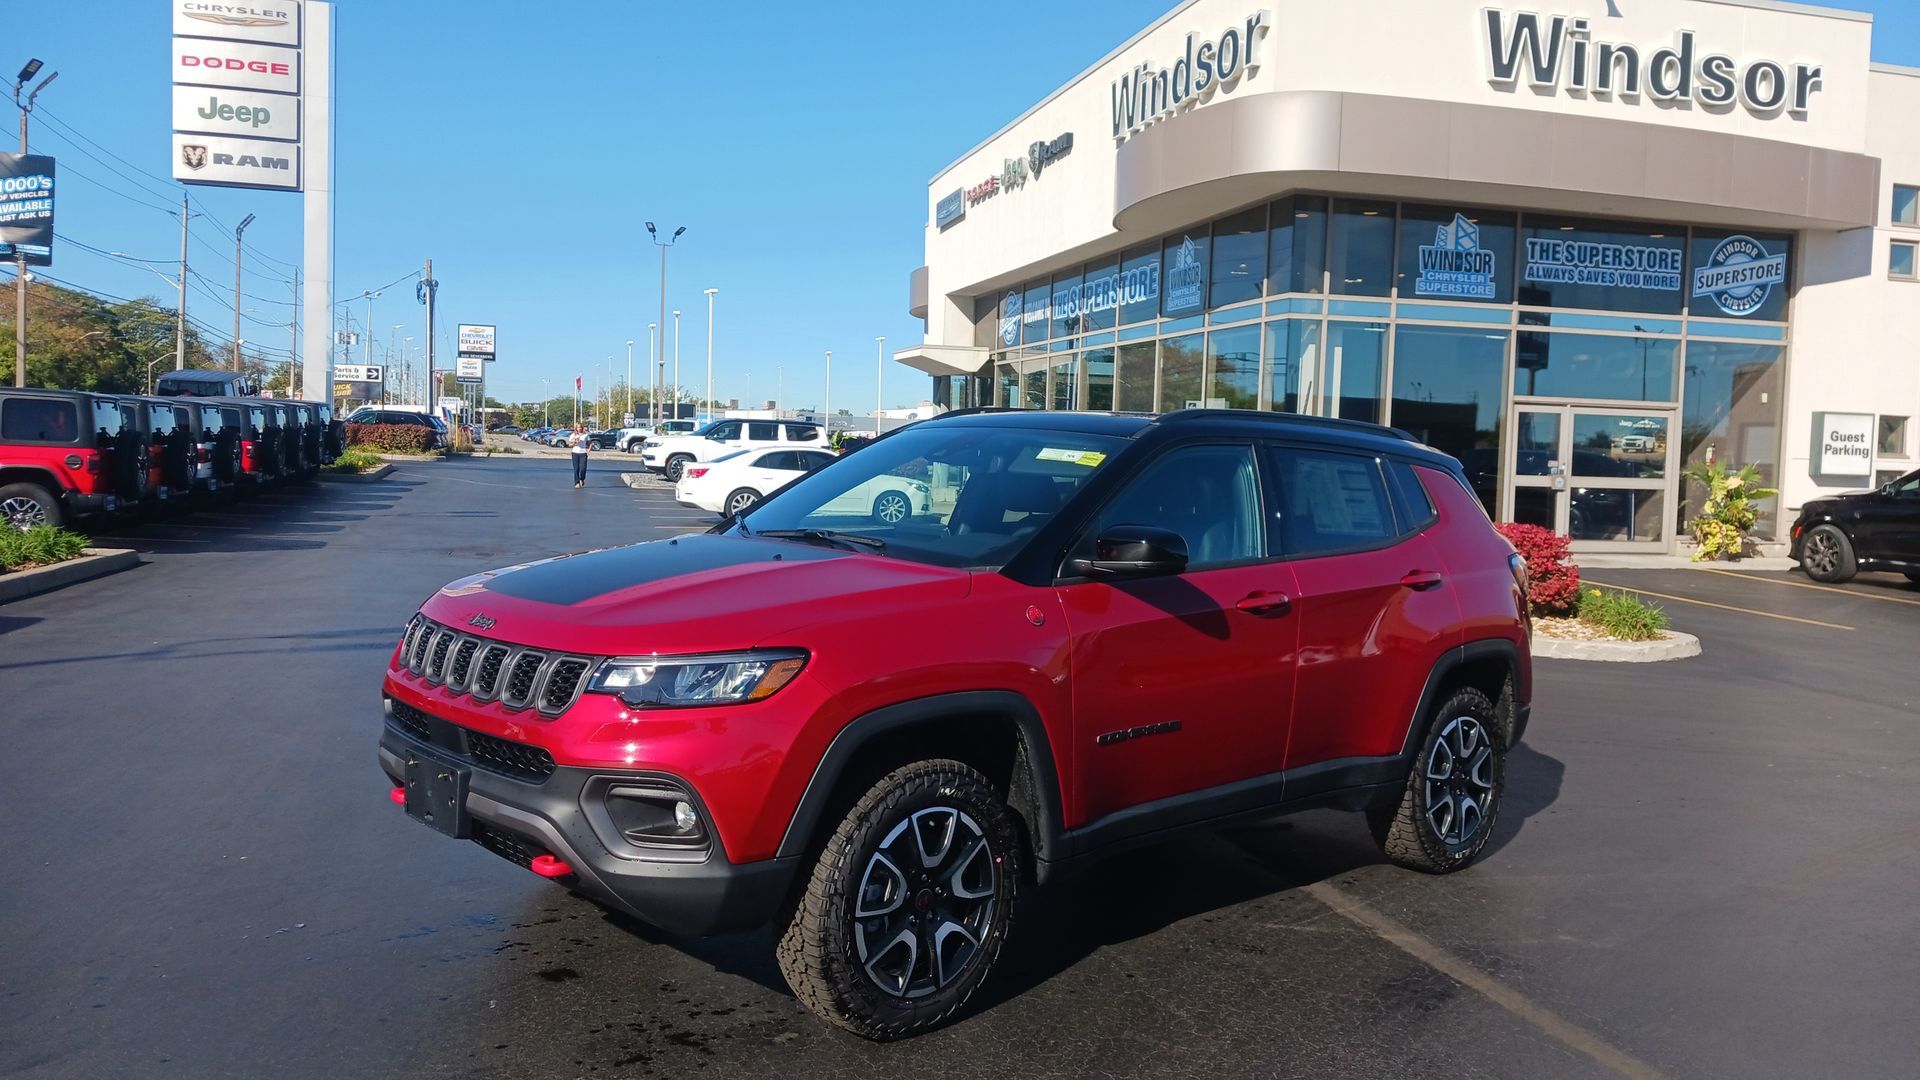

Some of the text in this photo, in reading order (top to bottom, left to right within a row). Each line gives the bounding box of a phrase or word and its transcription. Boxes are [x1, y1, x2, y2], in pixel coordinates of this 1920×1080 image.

[183, 2, 288, 19] CHRYSLER
[181, 54, 290, 76] DODGE
[1485, 8, 1822, 111] Windsor
[1111, 10, 1267, 139] Windsor
[197, 96, 271, 128] Jeep
[213, 152, 289, 170] RAM
[9, 190, 50, 199] VEHICLES
[0, 210, 51, 222] UST ASK US
[1421, 248, 1493, 274] WINDSOR
[1528, 240, 1681, 271] THE SUPERSTORE
[1716, 241, 1758, 263] WINDSOR
[1427, 271, 1485, 283] CHRYSLER
[1527, 266, 1680, 289] ALWAYS SAVES YOU MORE!
[1697, 263, 1781, 290] SUPERSTORE
[1069, 263, 1159, 317] SUPERSTORE
[1419, 281, 1493, 295] SUPERSTORE
[1721, 287, 1763, 310] CHRYSLER
[1830, 430, 1865, 443] Guest
[1824, 443, 1869, 459] Parking
